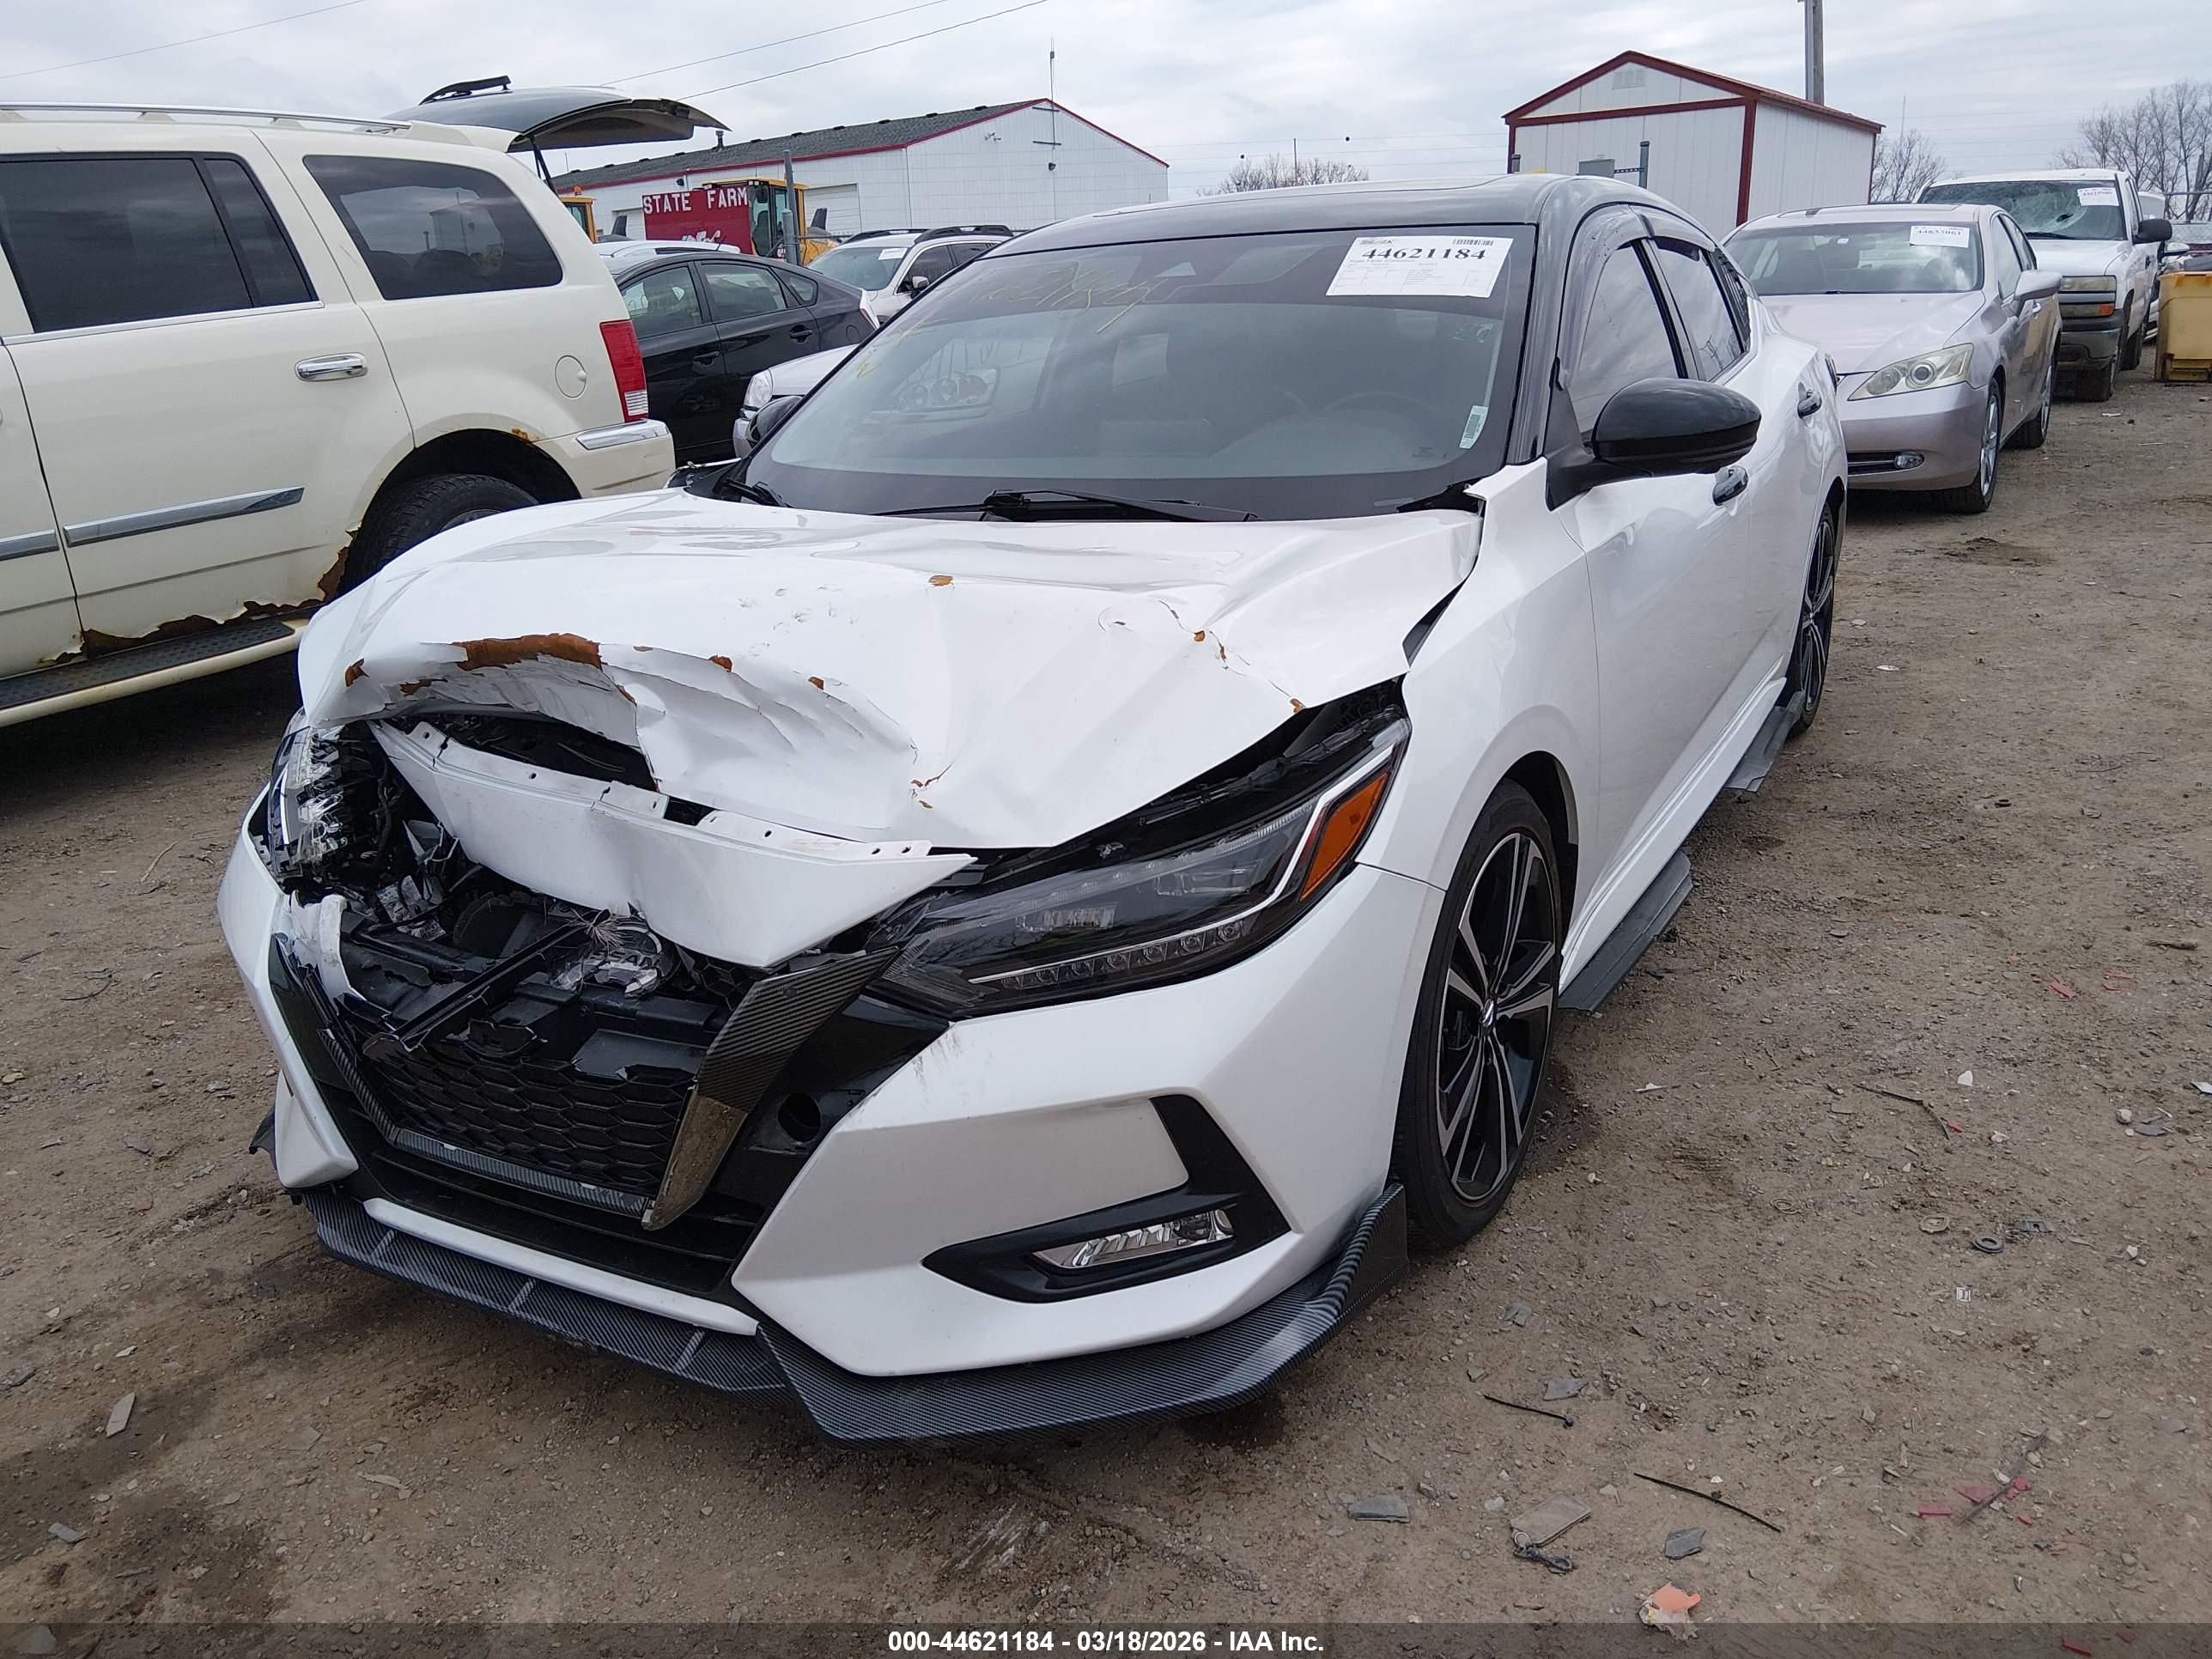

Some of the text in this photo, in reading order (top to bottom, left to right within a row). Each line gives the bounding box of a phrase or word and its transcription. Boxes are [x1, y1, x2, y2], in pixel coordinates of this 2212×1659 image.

[643, 186, 748, 214] STATE FARM
[1362, 248, 1486, 259] 44621184
